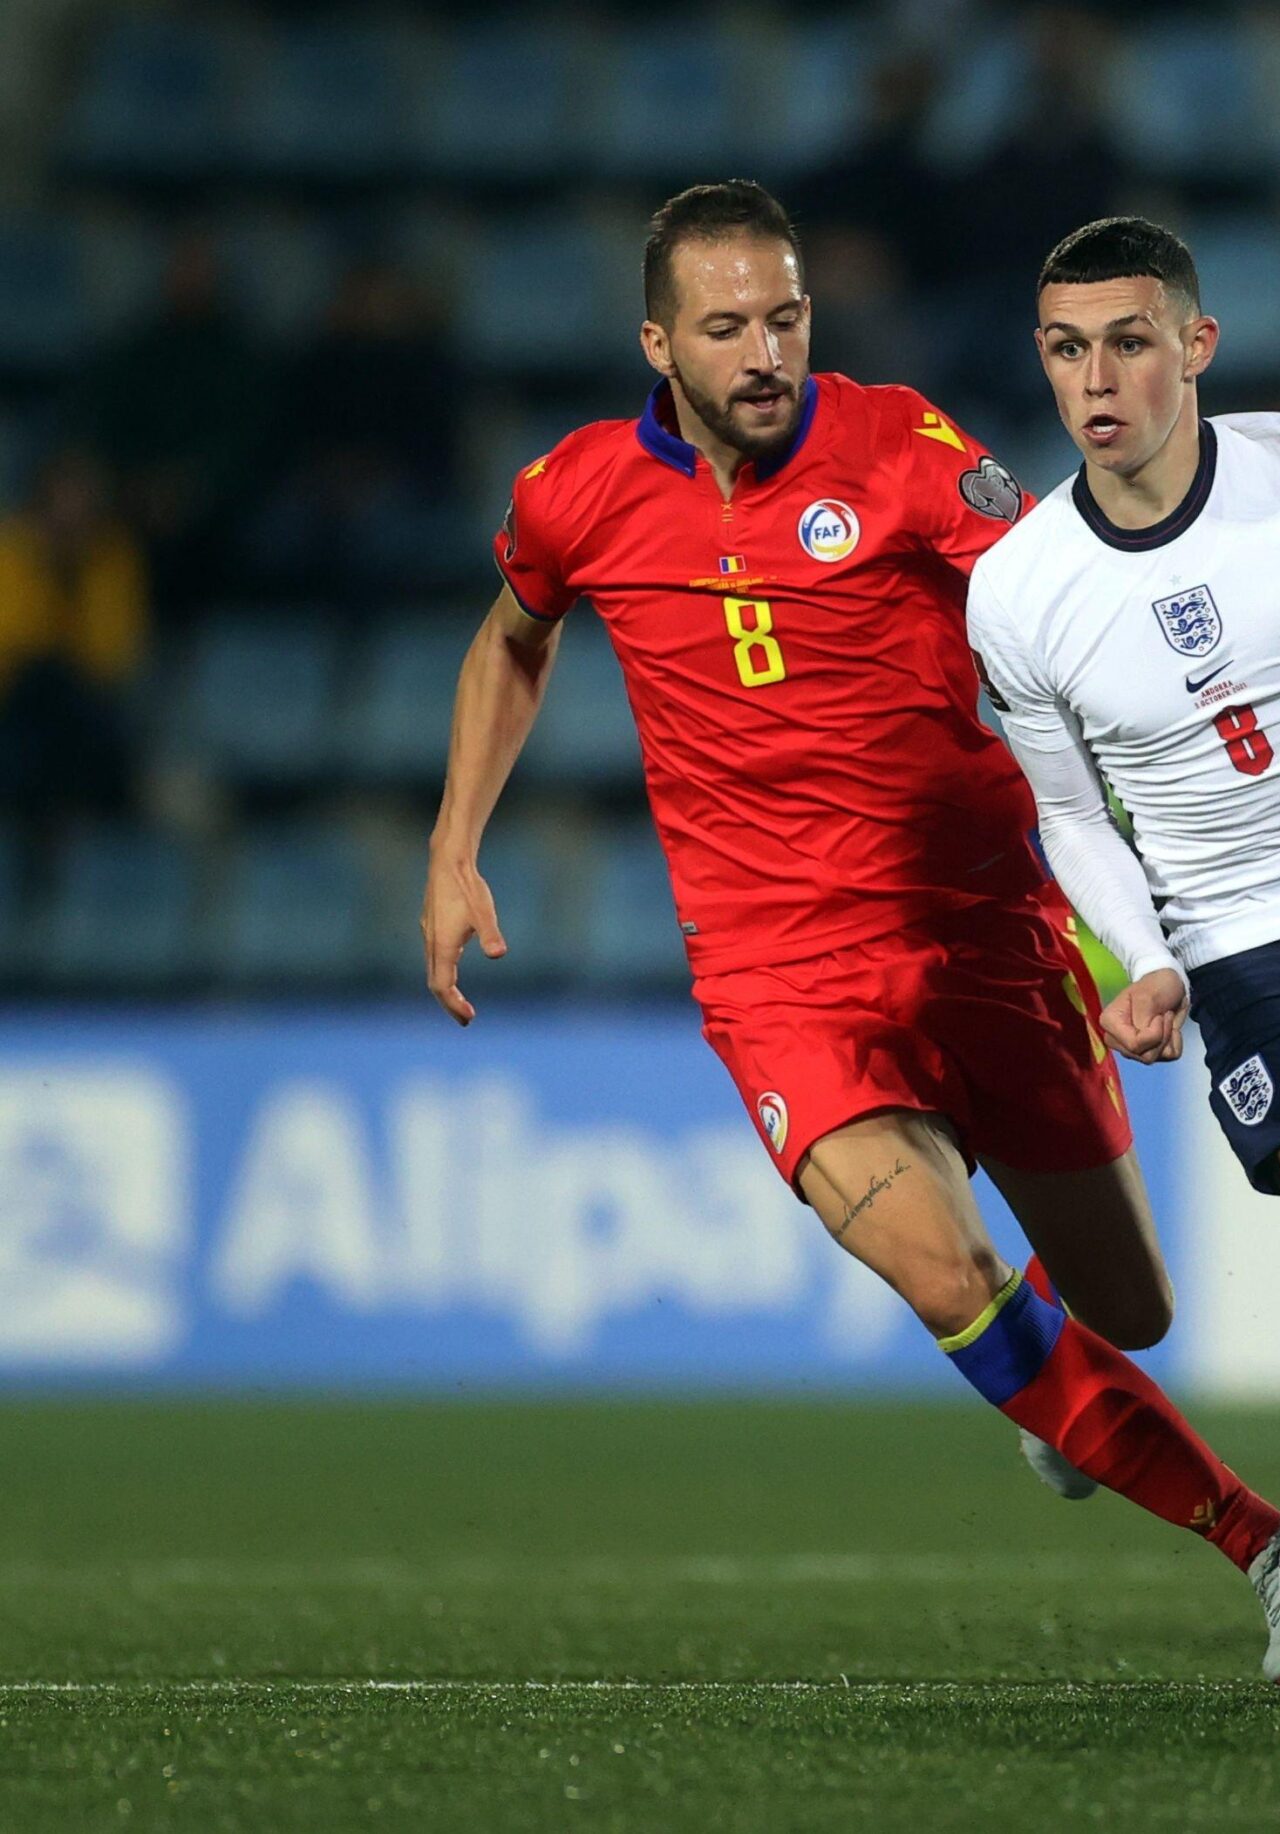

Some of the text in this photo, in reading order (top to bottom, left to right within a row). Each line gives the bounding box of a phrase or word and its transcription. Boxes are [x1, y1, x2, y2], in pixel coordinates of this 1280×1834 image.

[814, 524, 841, 540] FAF
[723, 597, 786, 688] 8
[1200, 680, 1234, 698] ANDORRA
[1200, 690, 1231, 707] OCTOBER
[1212, 703, 1275, 776] 8
